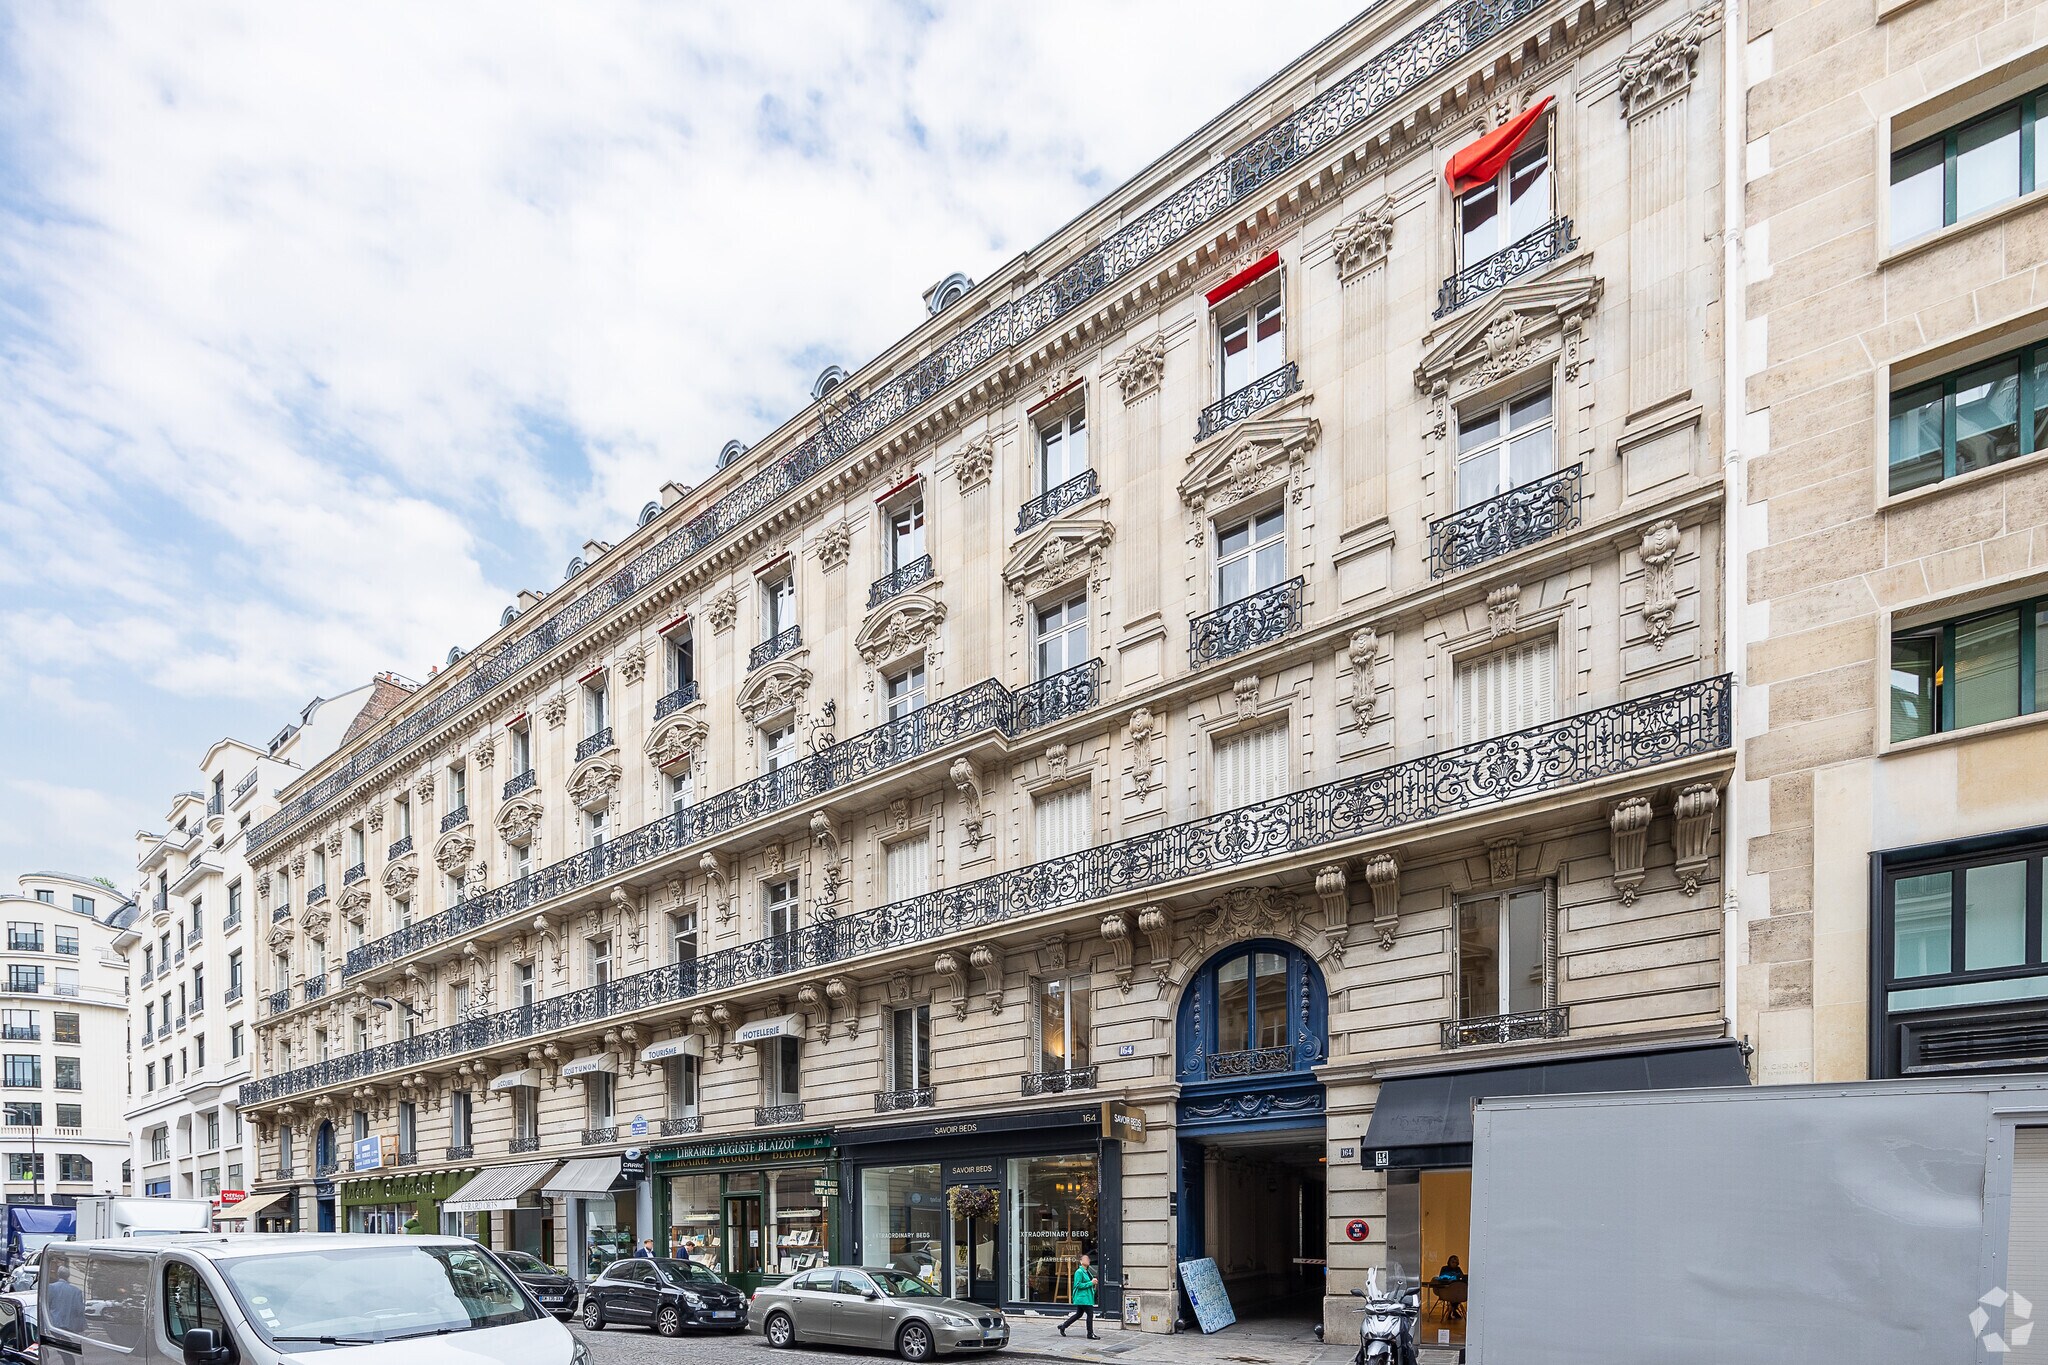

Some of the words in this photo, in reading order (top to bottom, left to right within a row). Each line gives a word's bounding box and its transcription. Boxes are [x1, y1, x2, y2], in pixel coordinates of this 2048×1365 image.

[742, 1025, 780, 1040] HOTELLERIE
[648, 1046, 677, 1059] TOURISME
[1119, 1045, 1133, 1055] 164
[1082, 1114, 1096, 1123] 164
[1113, 1113, 1131, 1125] SAVOIR
[1130, 1117, 1142, 1127] BEDS
[934, 1125, 958, 1135] SAVOIR
[959, 1123, 977, 1133] BEDS
[813, 1137, 823, 1146] 164
[676, 1145, 716, 1159] LIBRAIRIE
[717, 1142, 756, 1155] AUGUSTE
[758, 1139, 796, 1152] BLAIZOT
[1342, 1148, 1352, 1157] 164
[718, 1153, 761, 1164] AUGUSTE
[772, 1149, 818, 1160] BLAIZOT
[952, 1166, 975, 1174] SAVOIR
[976, 1164, 992, 1173] BEDS
[344, 1184, 374, 1200] PACIFIC
[383, 1181, 436, 1197] COMPAGNIE
[916, 1231, 930, 1239] BEDS
[1016, 1230, 1069, 1238] XTRAORDINARY
[1071, 1230, 1089, 1238] BEDS
